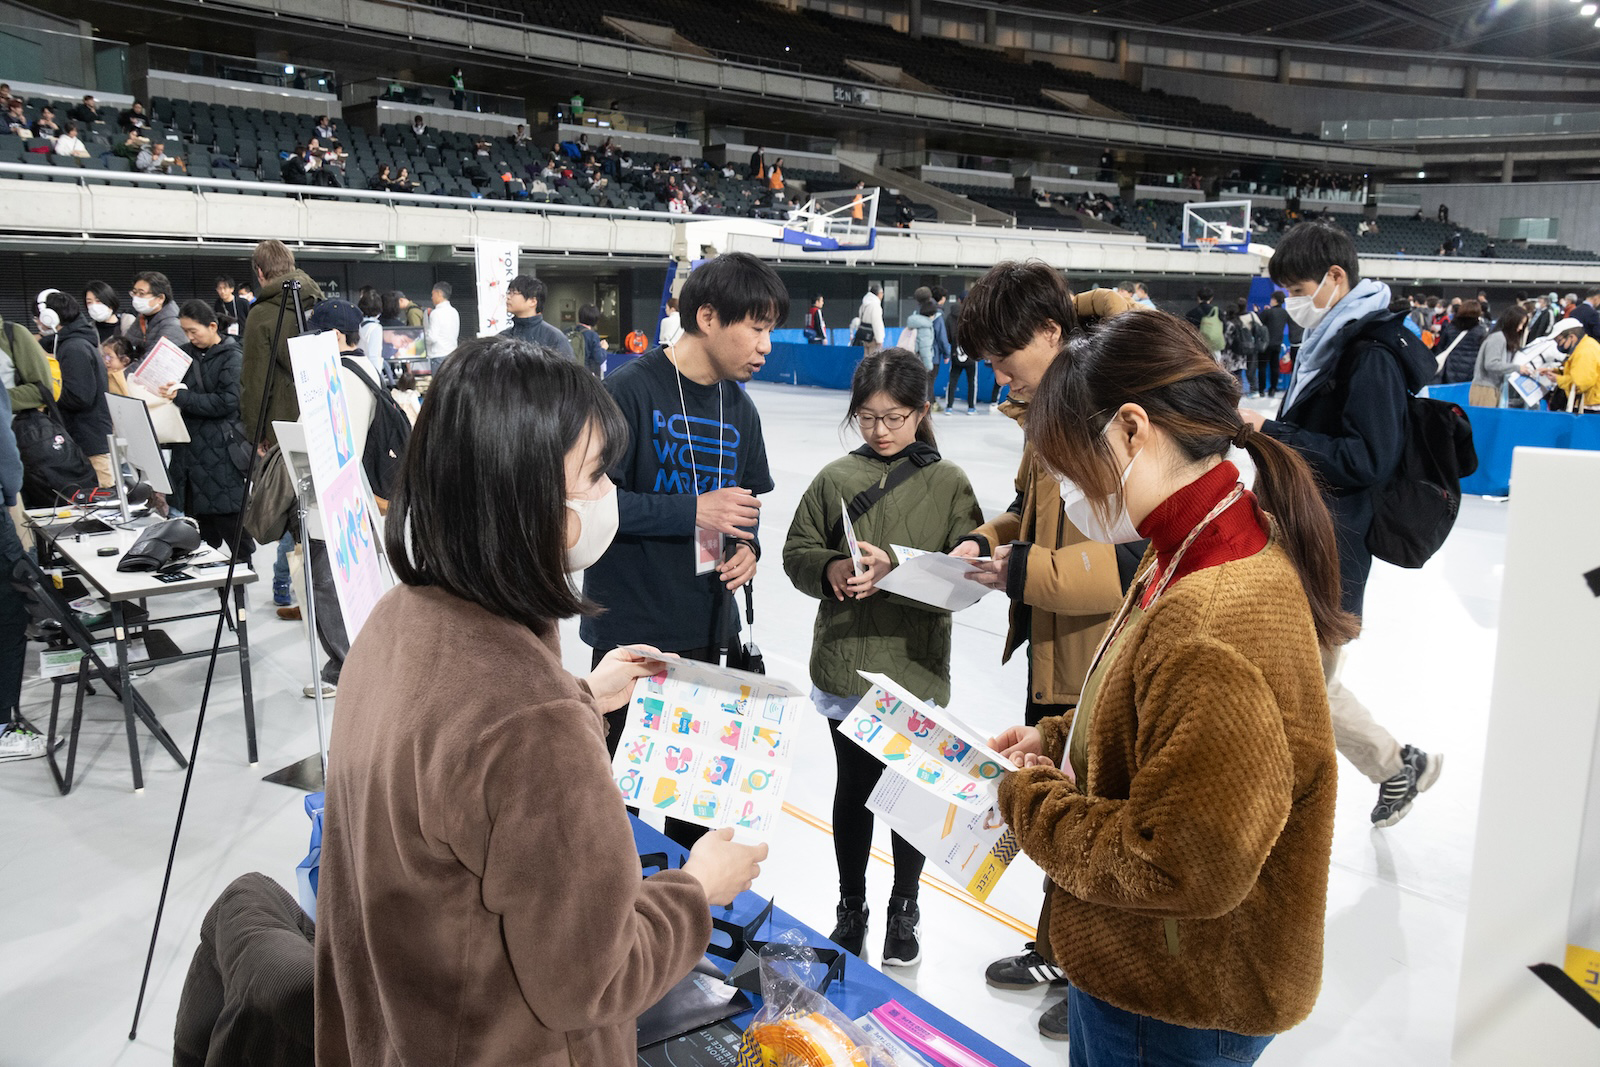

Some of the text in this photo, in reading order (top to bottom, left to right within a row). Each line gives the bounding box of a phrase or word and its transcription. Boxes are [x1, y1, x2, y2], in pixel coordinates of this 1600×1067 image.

[976, 863, 996, 892] ココテープ
[699, 1030, 715, 1042] KIT
[704, 1045, 730, 1067] VISION
[711, 1040, 738, 1066] RIENCE
